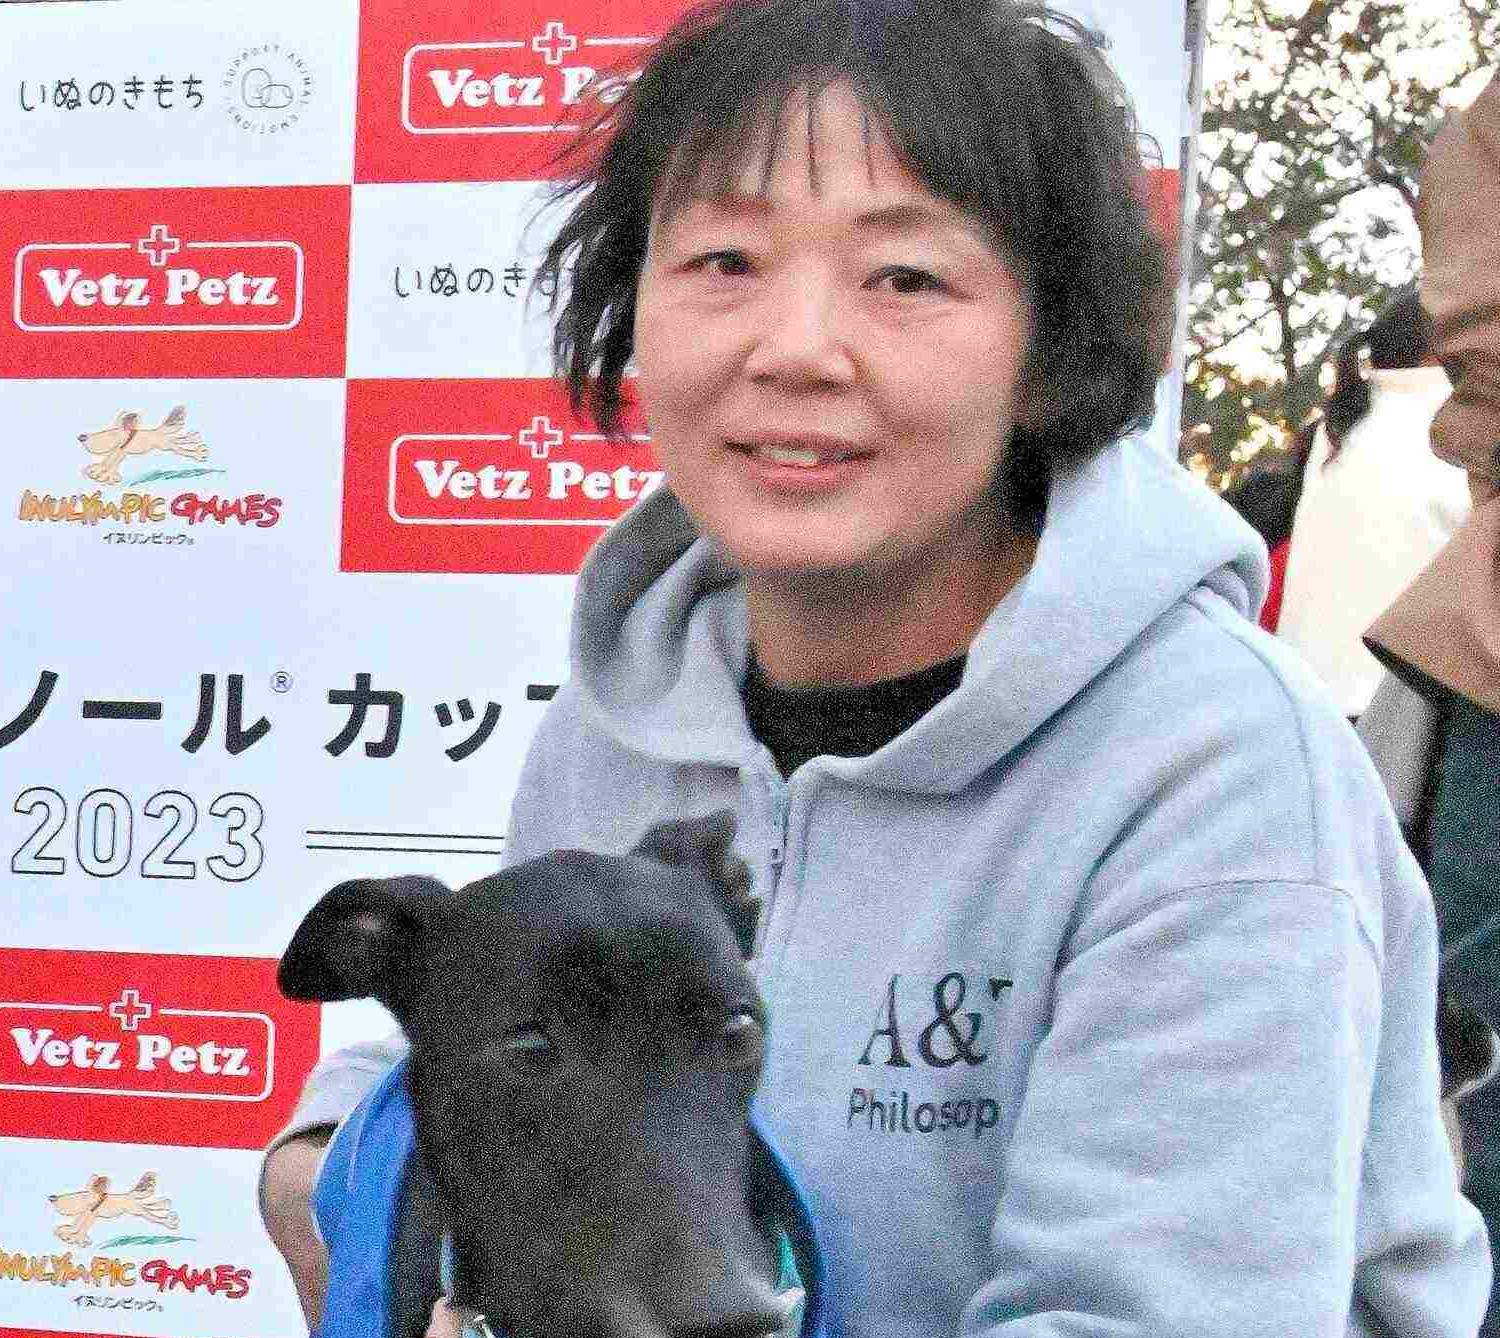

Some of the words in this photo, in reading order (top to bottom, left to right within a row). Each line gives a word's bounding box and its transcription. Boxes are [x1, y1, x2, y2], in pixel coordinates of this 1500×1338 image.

[20, 75, 204, 112] いぬのきもち
[429, 68, 544, 107] Vetz
[40, 269, 151, 307] Vetz
[164, 268, 278, 305] Petz
[415, 460, 532, 499] Vetz
[548, 461, 666, 500] Petz
[170, 492, 282, 528] GAMES
[11, 786, 265, 883] 2023
[10, 1026, 122, 1070] Vetz
[136, 1034, 250, 1077] Petz
[140, 1259, 252, 1300] GAMES
